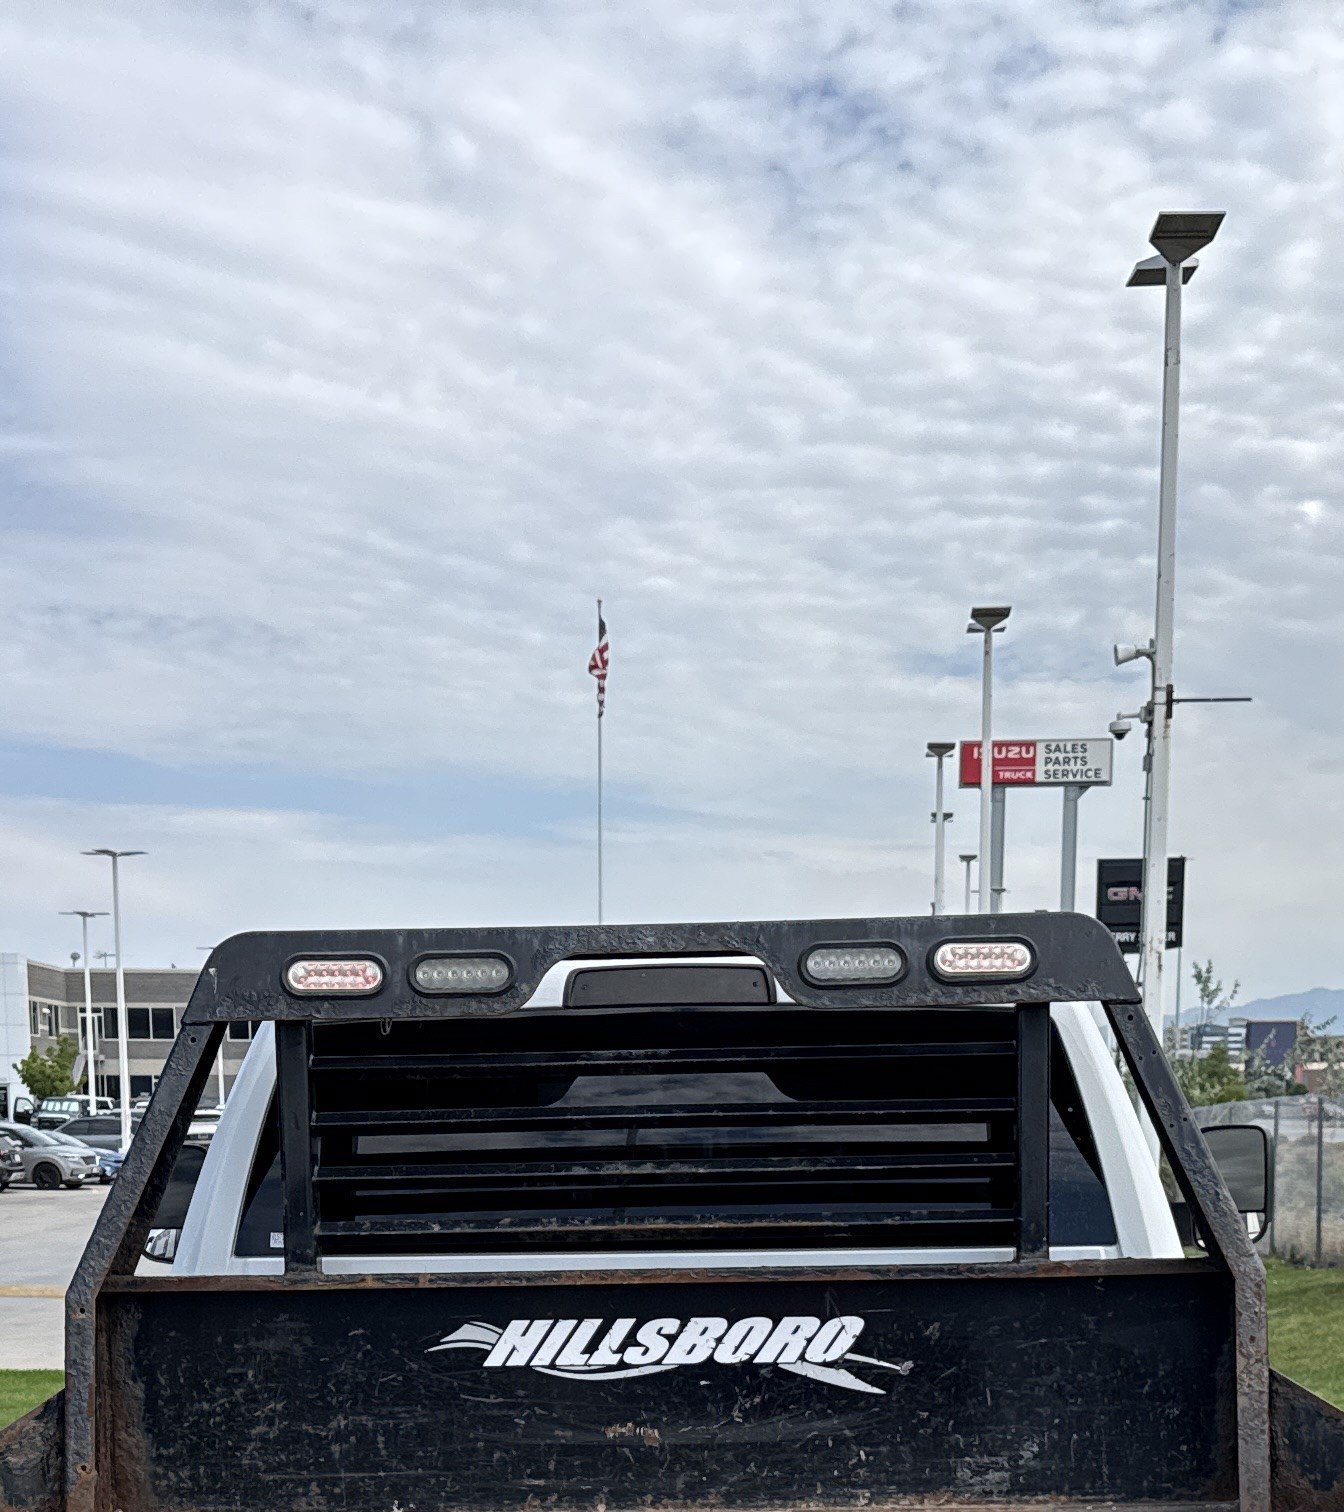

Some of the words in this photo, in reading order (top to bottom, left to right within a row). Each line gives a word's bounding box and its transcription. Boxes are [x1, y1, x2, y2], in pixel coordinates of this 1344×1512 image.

[972, 745, 1034, 760] IUZU
[1044, 743, 1088, 754] SALES
[1044, 756, 1088, 767] PARTS
[998, 770, 1034, 780] TRUCK
[1043, 768, 1103, 780] SERVICE
[482, 1316, 865, 1368] HILLSBORO
